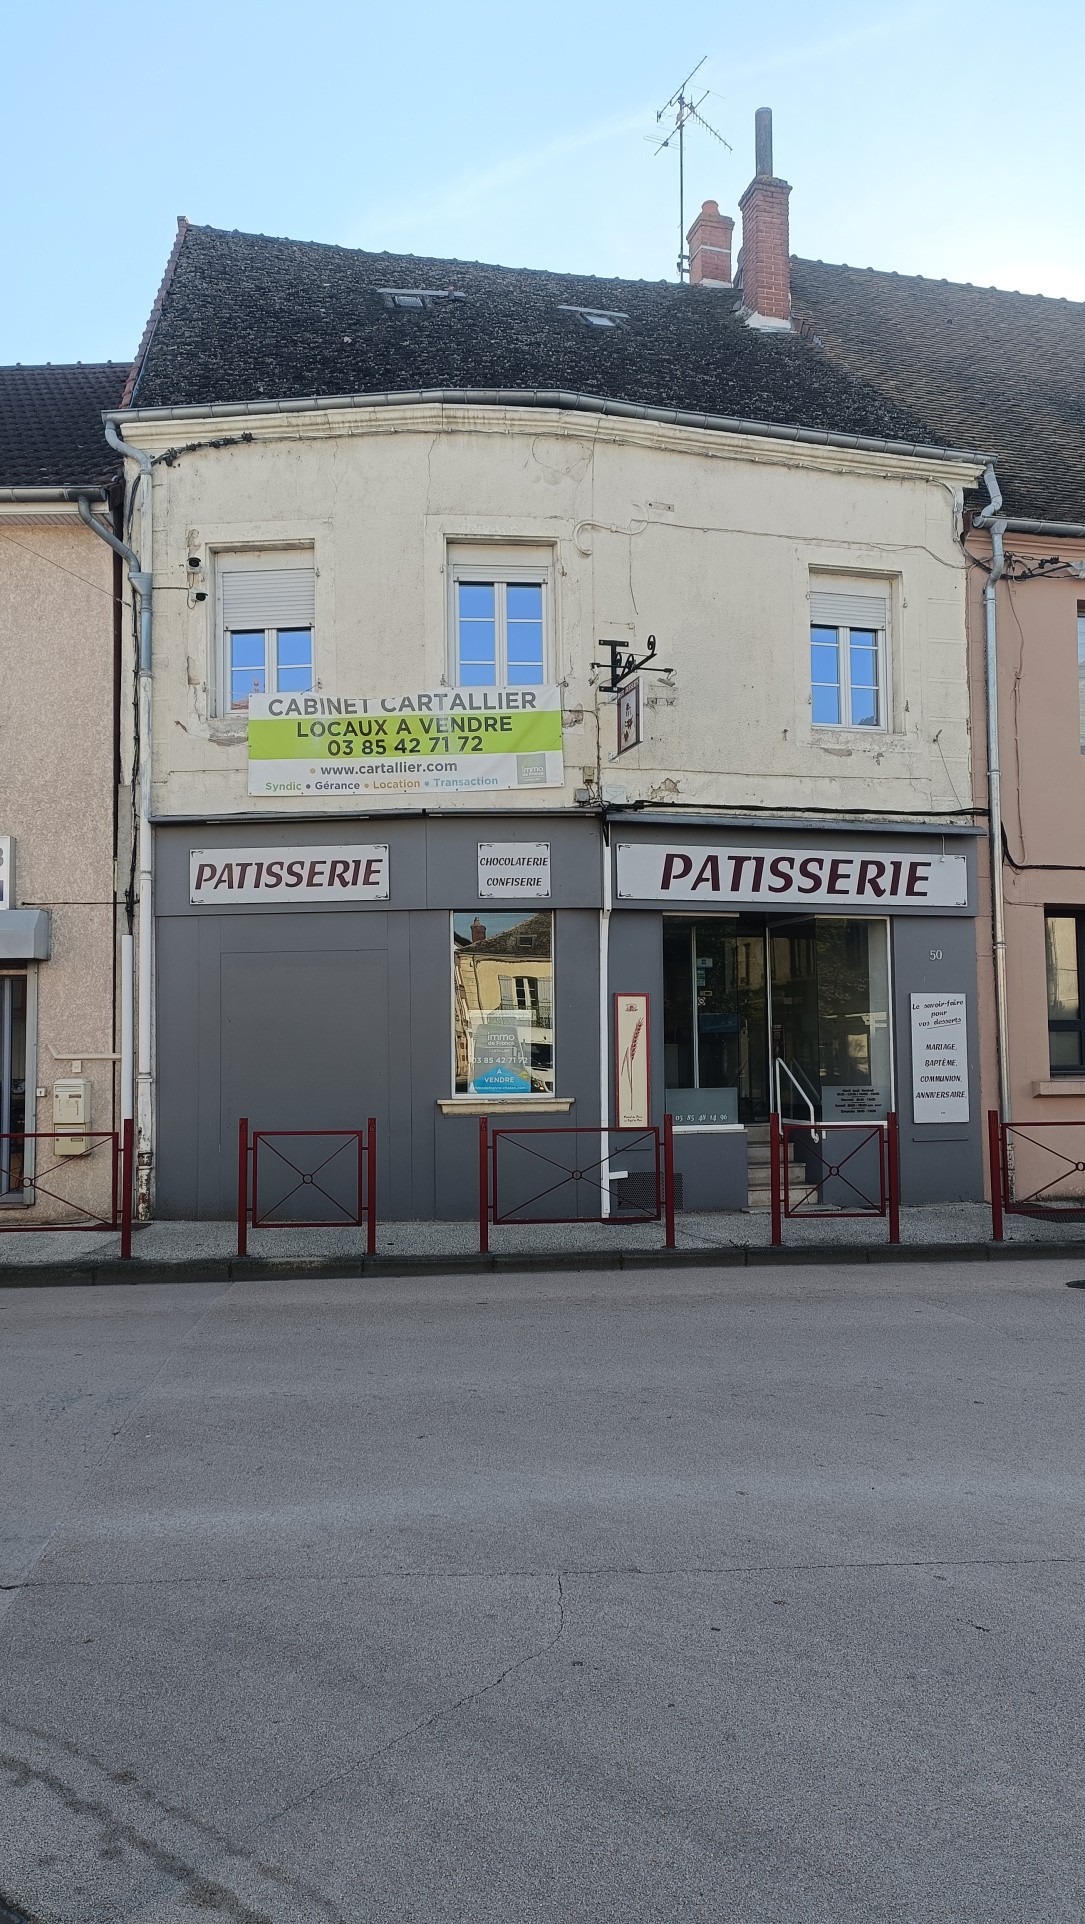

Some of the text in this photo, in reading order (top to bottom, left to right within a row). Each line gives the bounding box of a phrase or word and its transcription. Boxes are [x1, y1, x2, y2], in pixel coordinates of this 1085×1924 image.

[268, 691, 537, 717] CABINET CARTALLIER
[297, 715, 513, 738] LOCAUX A VENDRE
[327, 735, 483, 757] 03 85 42 71 72
[320, 761, 458, 776] www.cartallier.com
[265, 776, 499, 791] Syndic Gérance Location Transaction
[479, 857, 549, 867] CHOCOLATERIE
[194, 858, 384, 891] PATISSERIE
[660, 853, 932, 898] PATISSERIE
[486, 877, 543, 887] CONFISERIE
[929, 949, 943, 961] 50
[923, 999, 964, 1009] savoir-faire
[930, 1010, 948, 1018] pour
[933, 1017, 962, 1026] desserts
[487, 1032, 515, 1041] immo
[686, 1114, 695, 1122] 85
